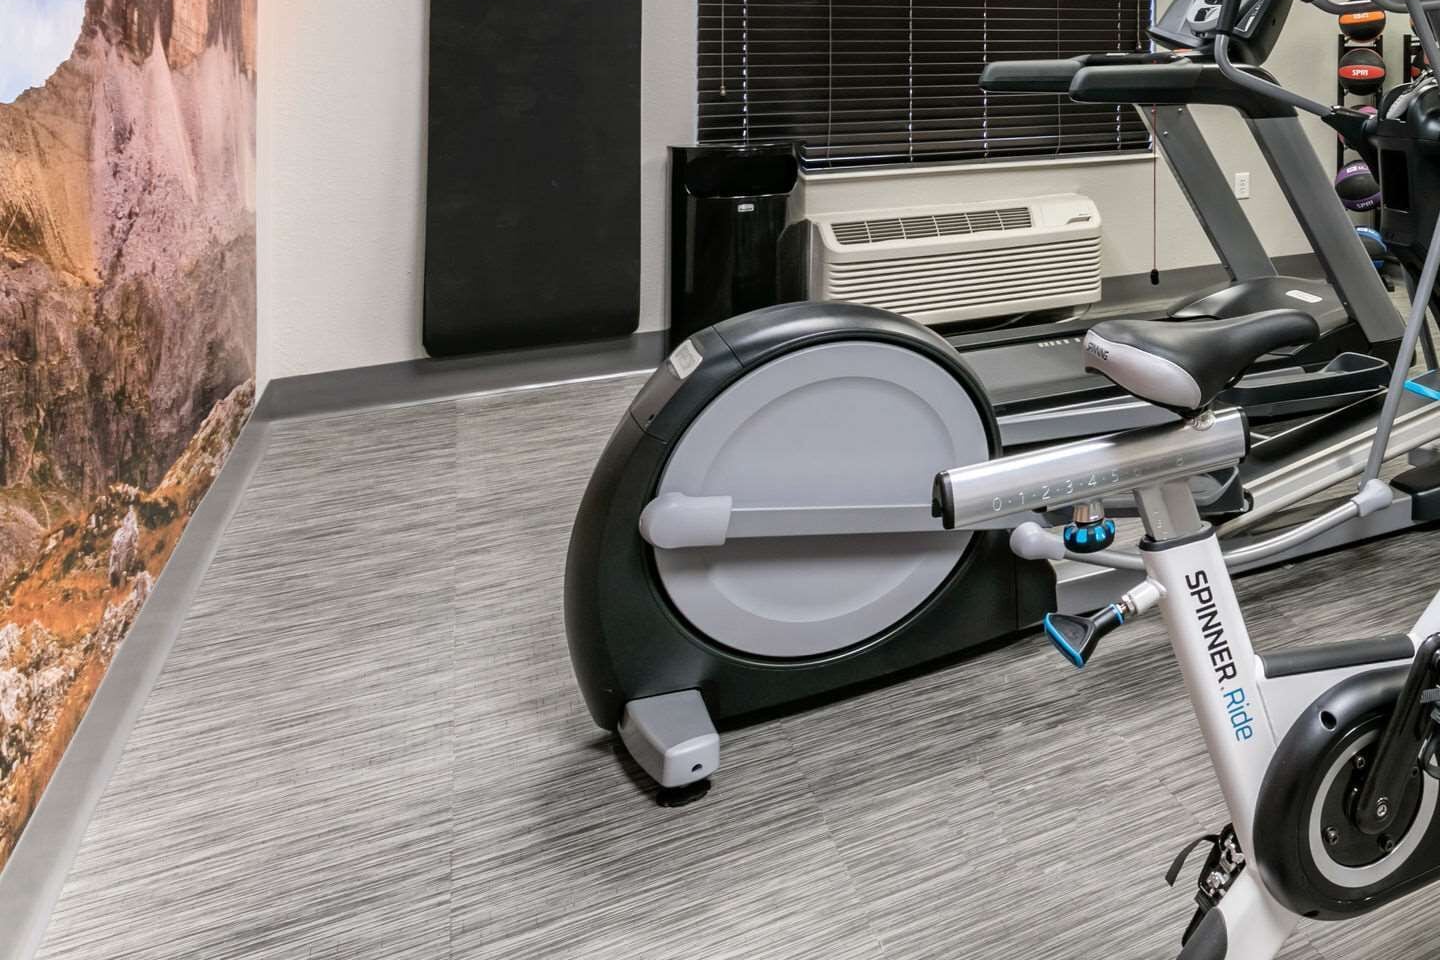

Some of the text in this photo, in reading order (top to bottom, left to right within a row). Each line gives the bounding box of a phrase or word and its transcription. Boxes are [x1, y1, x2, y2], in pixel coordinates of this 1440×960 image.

[992, 497, 1002, 512] 0
[1018, 492, 1025, 505] 1
[1042, 486, 1051, 500] 2
[1065, 480, 1073, 494] 3
[1088, 472, 1097, 486] 4
[1185, 569, 1254, 742] SPINNER Ride
